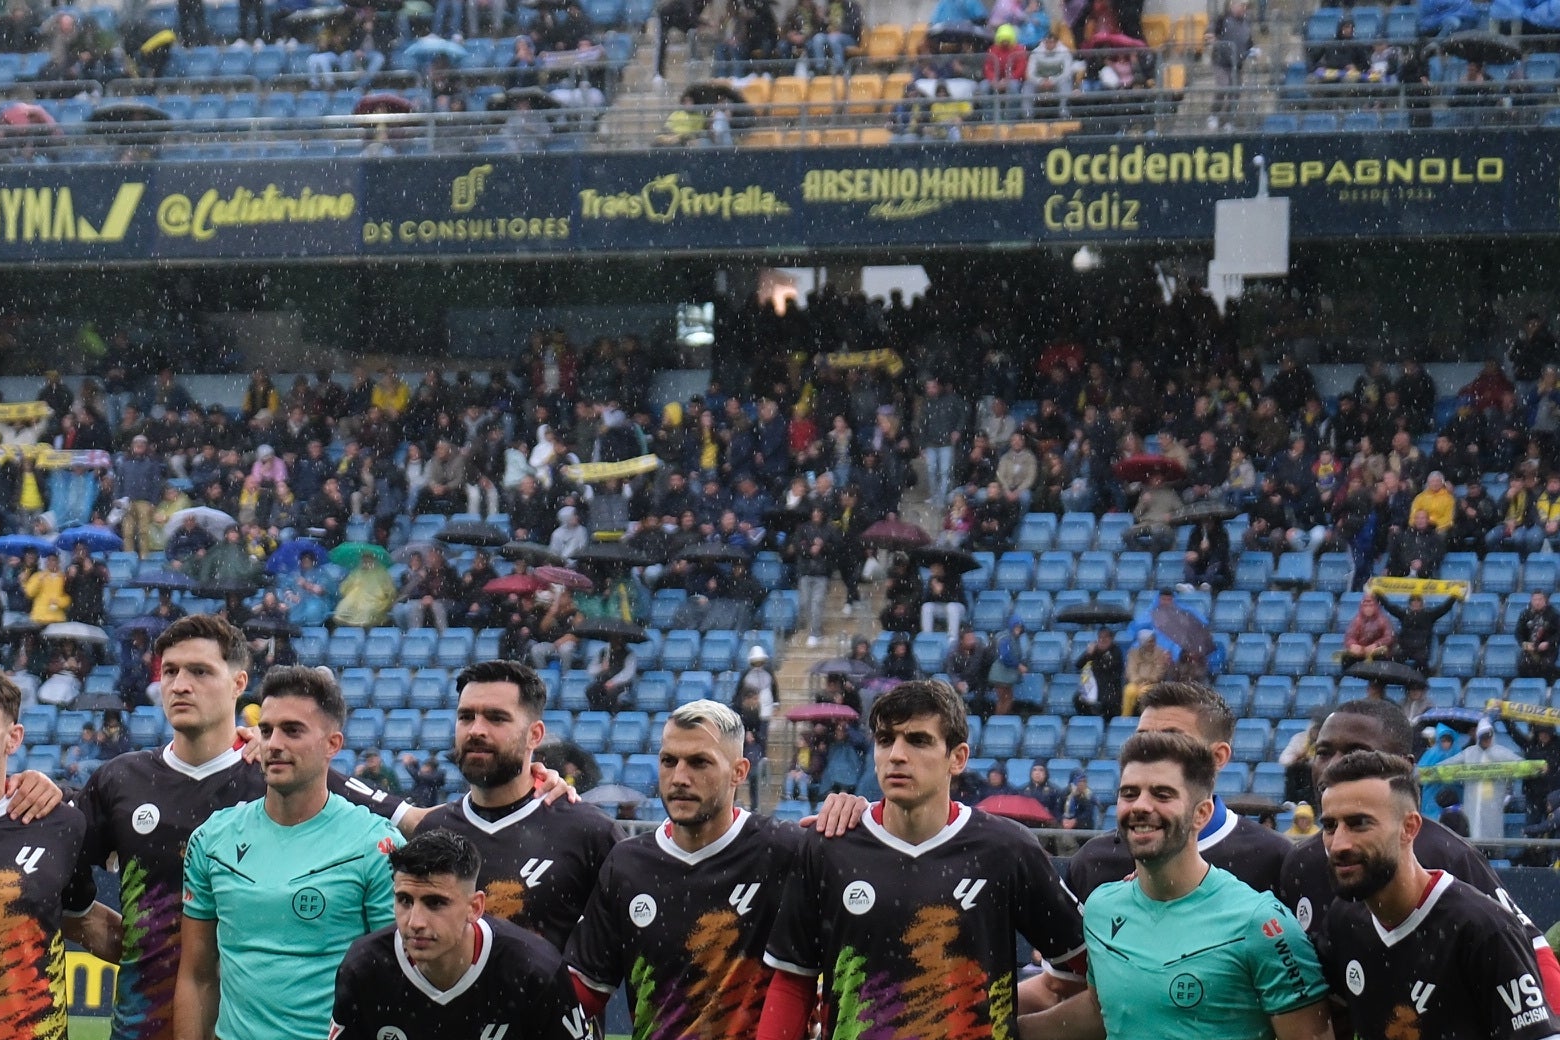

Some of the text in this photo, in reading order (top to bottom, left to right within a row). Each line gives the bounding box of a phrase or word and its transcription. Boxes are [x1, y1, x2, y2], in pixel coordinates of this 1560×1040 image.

[1046, 143, 1244, 185] Occidental
[1269, 157, 1504, 188] SPAGNOLO
[1044, 189, 1141, 231] Cádiz
[363, 217, 570, 244] DS CONSULTORES
[1496, 973, 1544, 1015] VS
[1511, 1006, 1550, 1031] RACISM
